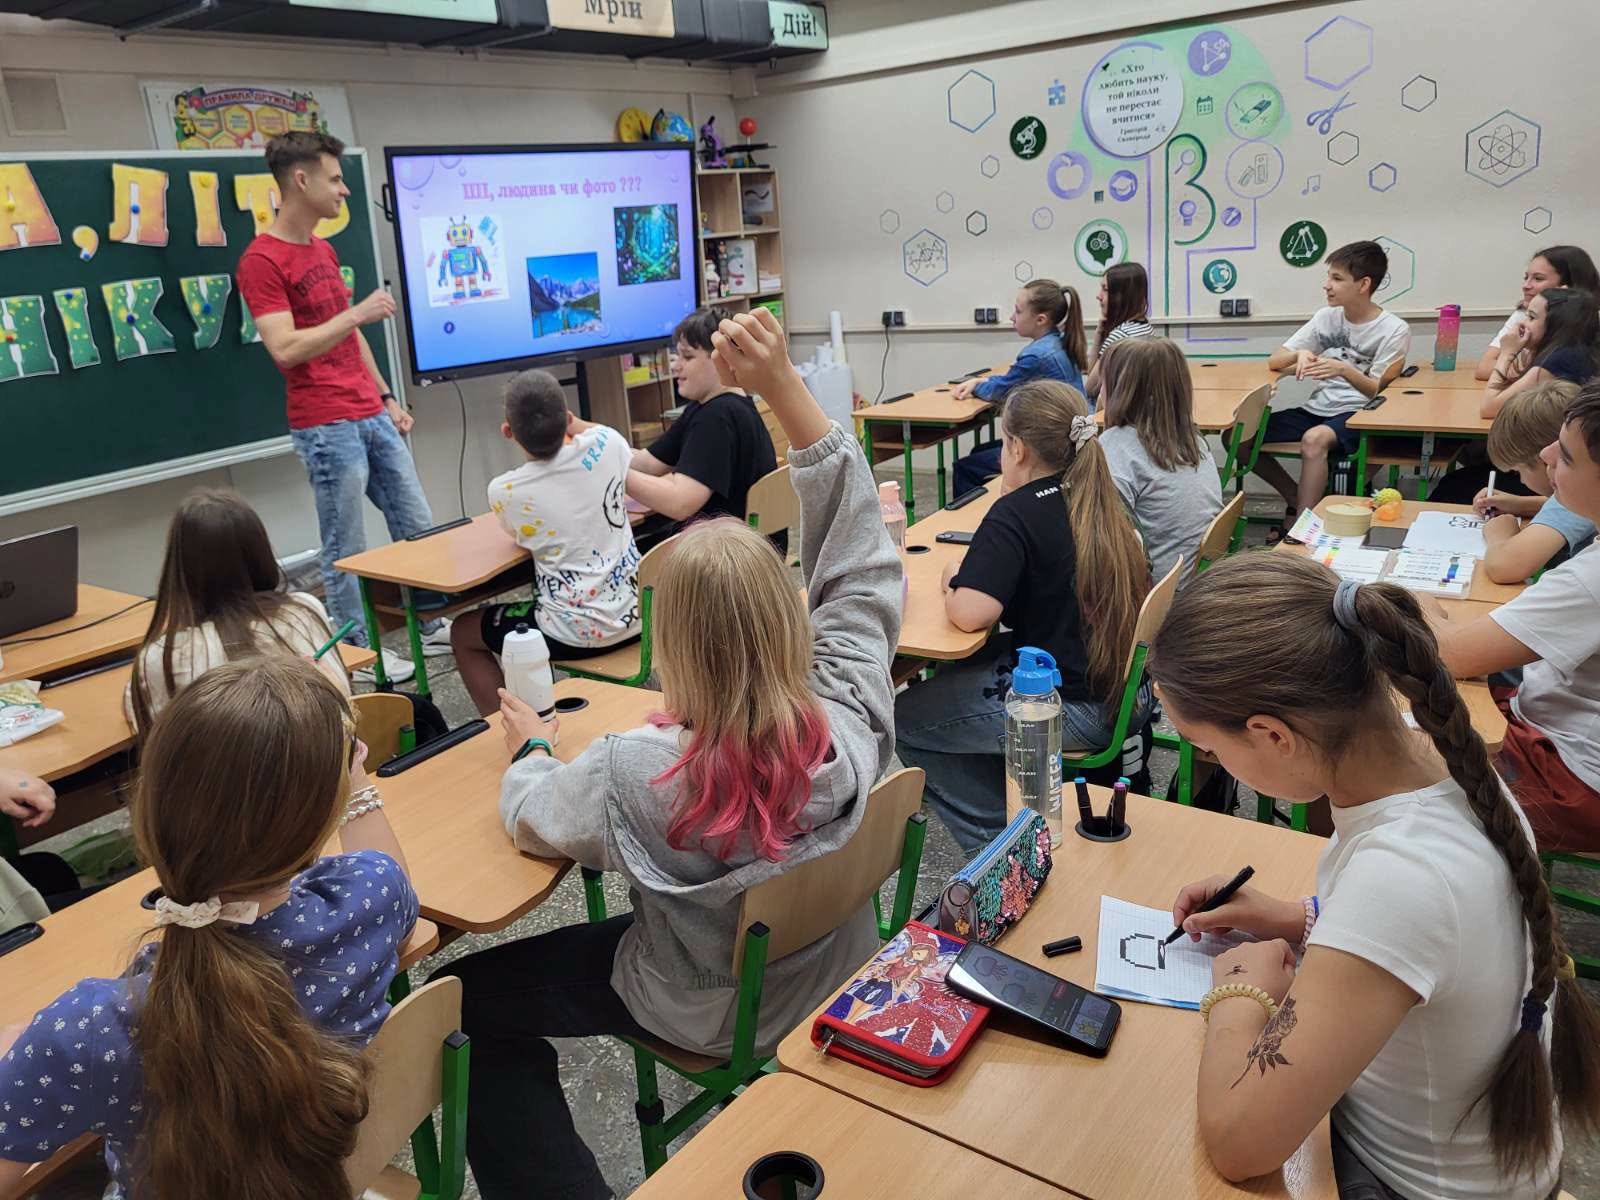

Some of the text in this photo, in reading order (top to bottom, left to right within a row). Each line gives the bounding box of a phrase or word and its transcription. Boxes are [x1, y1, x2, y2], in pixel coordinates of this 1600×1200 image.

[782, 13, 817, 39] Дій!
[1099, 73, 1168, 89] любить науку,
[1108, 87, 1159, 100] той ніколи
[497, 184, 556, 200] людина
[560, 182, 579, 195] чи
[582, 178, 617, 198] фото
[619, 176, 642, 193] ???
